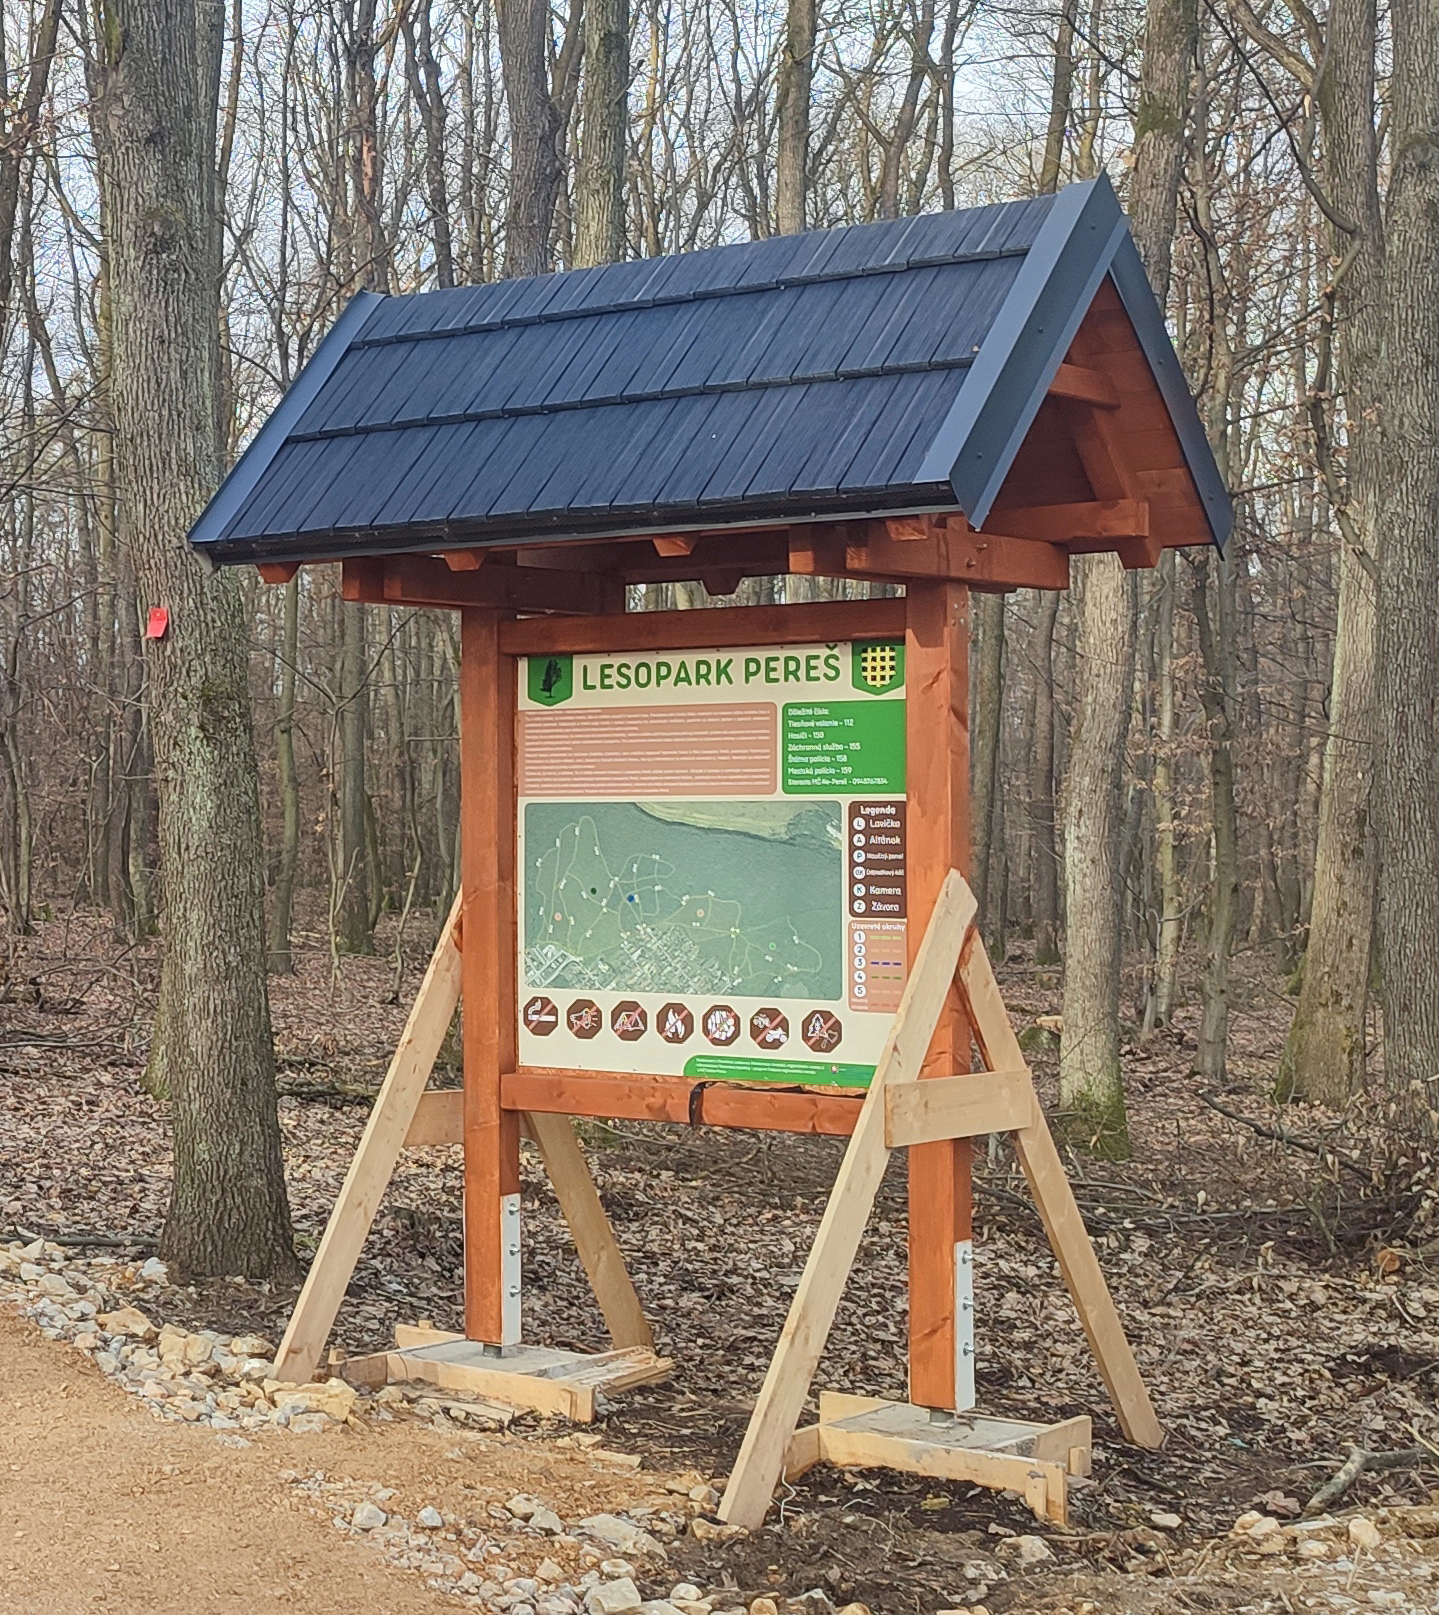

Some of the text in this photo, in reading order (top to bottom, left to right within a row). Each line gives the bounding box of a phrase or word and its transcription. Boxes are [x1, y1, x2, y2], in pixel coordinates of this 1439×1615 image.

[582, 643, 841, 690] LESOPARK PEREŠ
[844, 718, 854, 726] 112
[813, 731, 824, 739] 150
[788, 742, 822, 751] Záchranná
[823, 742, 843, 750] služba
[849, 742, 861, 750] 155
[841, 766, 852, 774] 159
[860, 805, 896, 816] Legenda
[870, 818, 901, 828] Lavička
[870, 885, 902, 895] Kamera
[871, 900, 900, 911] Závora
